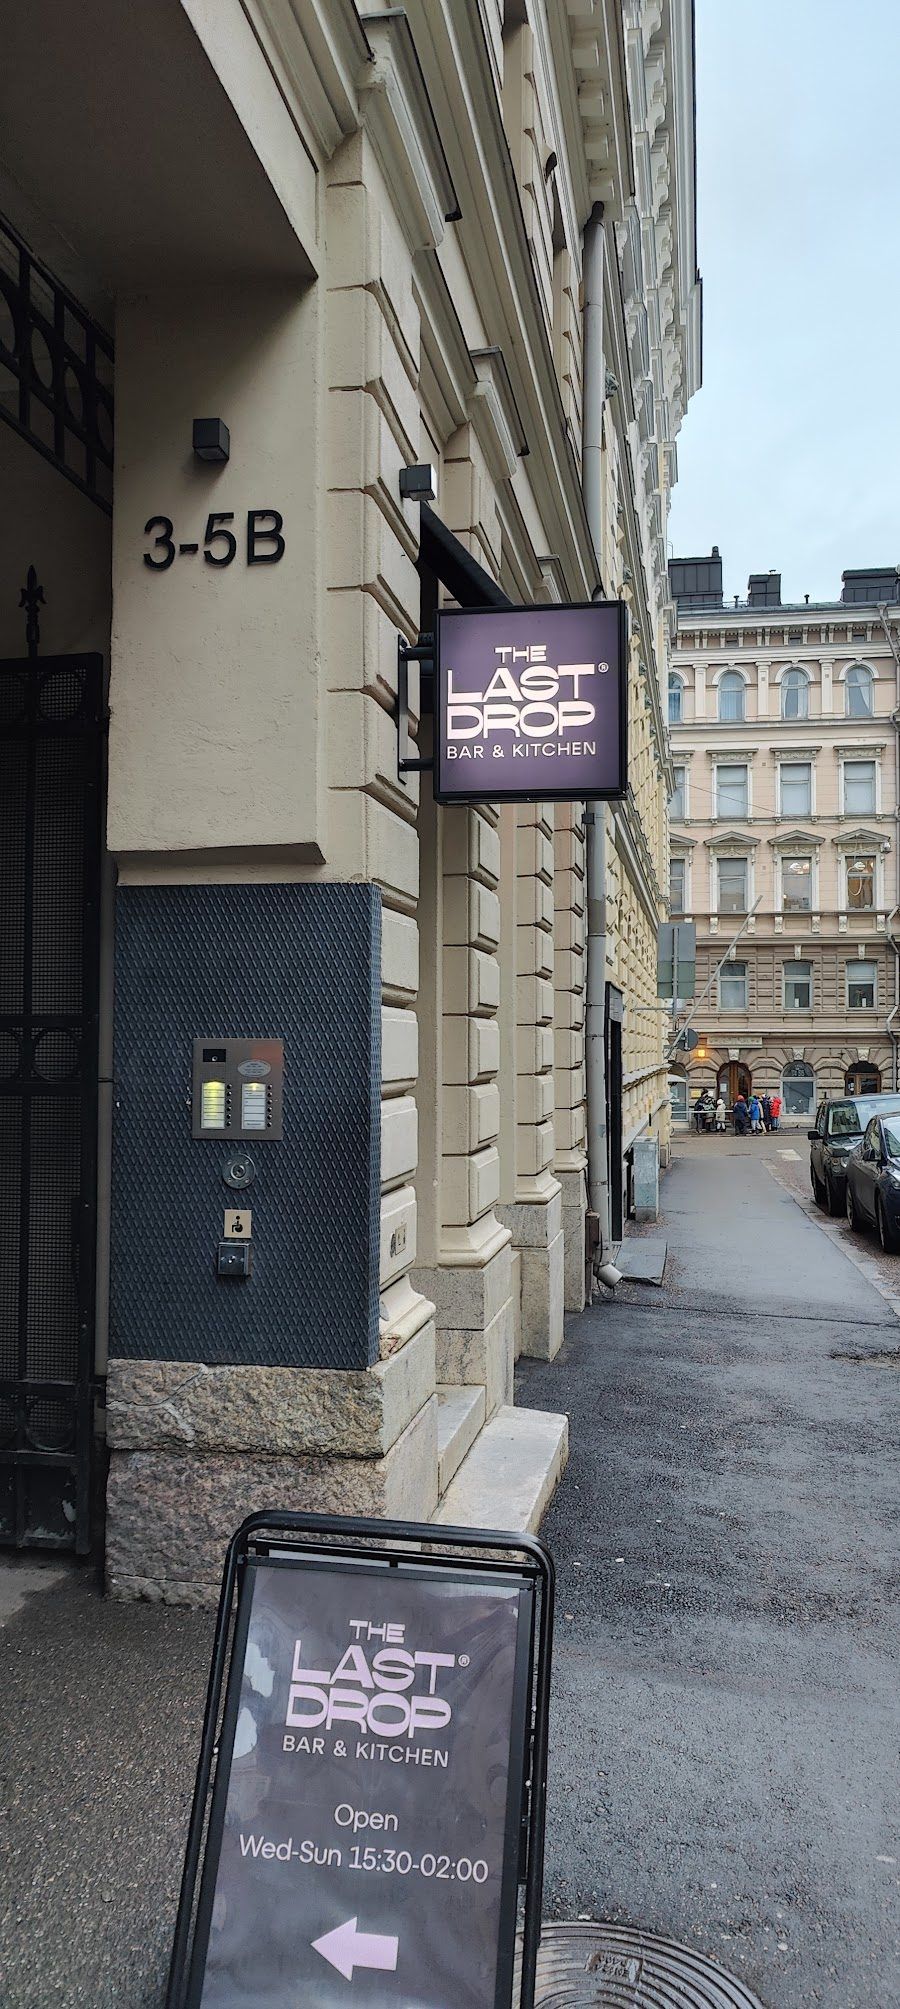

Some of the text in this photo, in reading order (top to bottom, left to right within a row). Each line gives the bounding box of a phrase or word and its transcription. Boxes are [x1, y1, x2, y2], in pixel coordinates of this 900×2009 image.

[143, 509, 285, 572] 3-5B
[495, 645, 546, 663] THE
[447, 664, 595, 704] LAST
[447, 701, 595, 740] DROP
[447, 742, 596, 760] BAR & KITCHEN
[349, 1620, 405, 1643] THE
[290, 1640, 455, 1694] LAST
[285, 1684, 451, 1738] DROP
[282, 1735, 448, 1767] BAR & KITCHEN
[334, 1804, 398, 1832] Open
[239, 1834, 488, 1883] Wed-Sun 15:30-02:00
